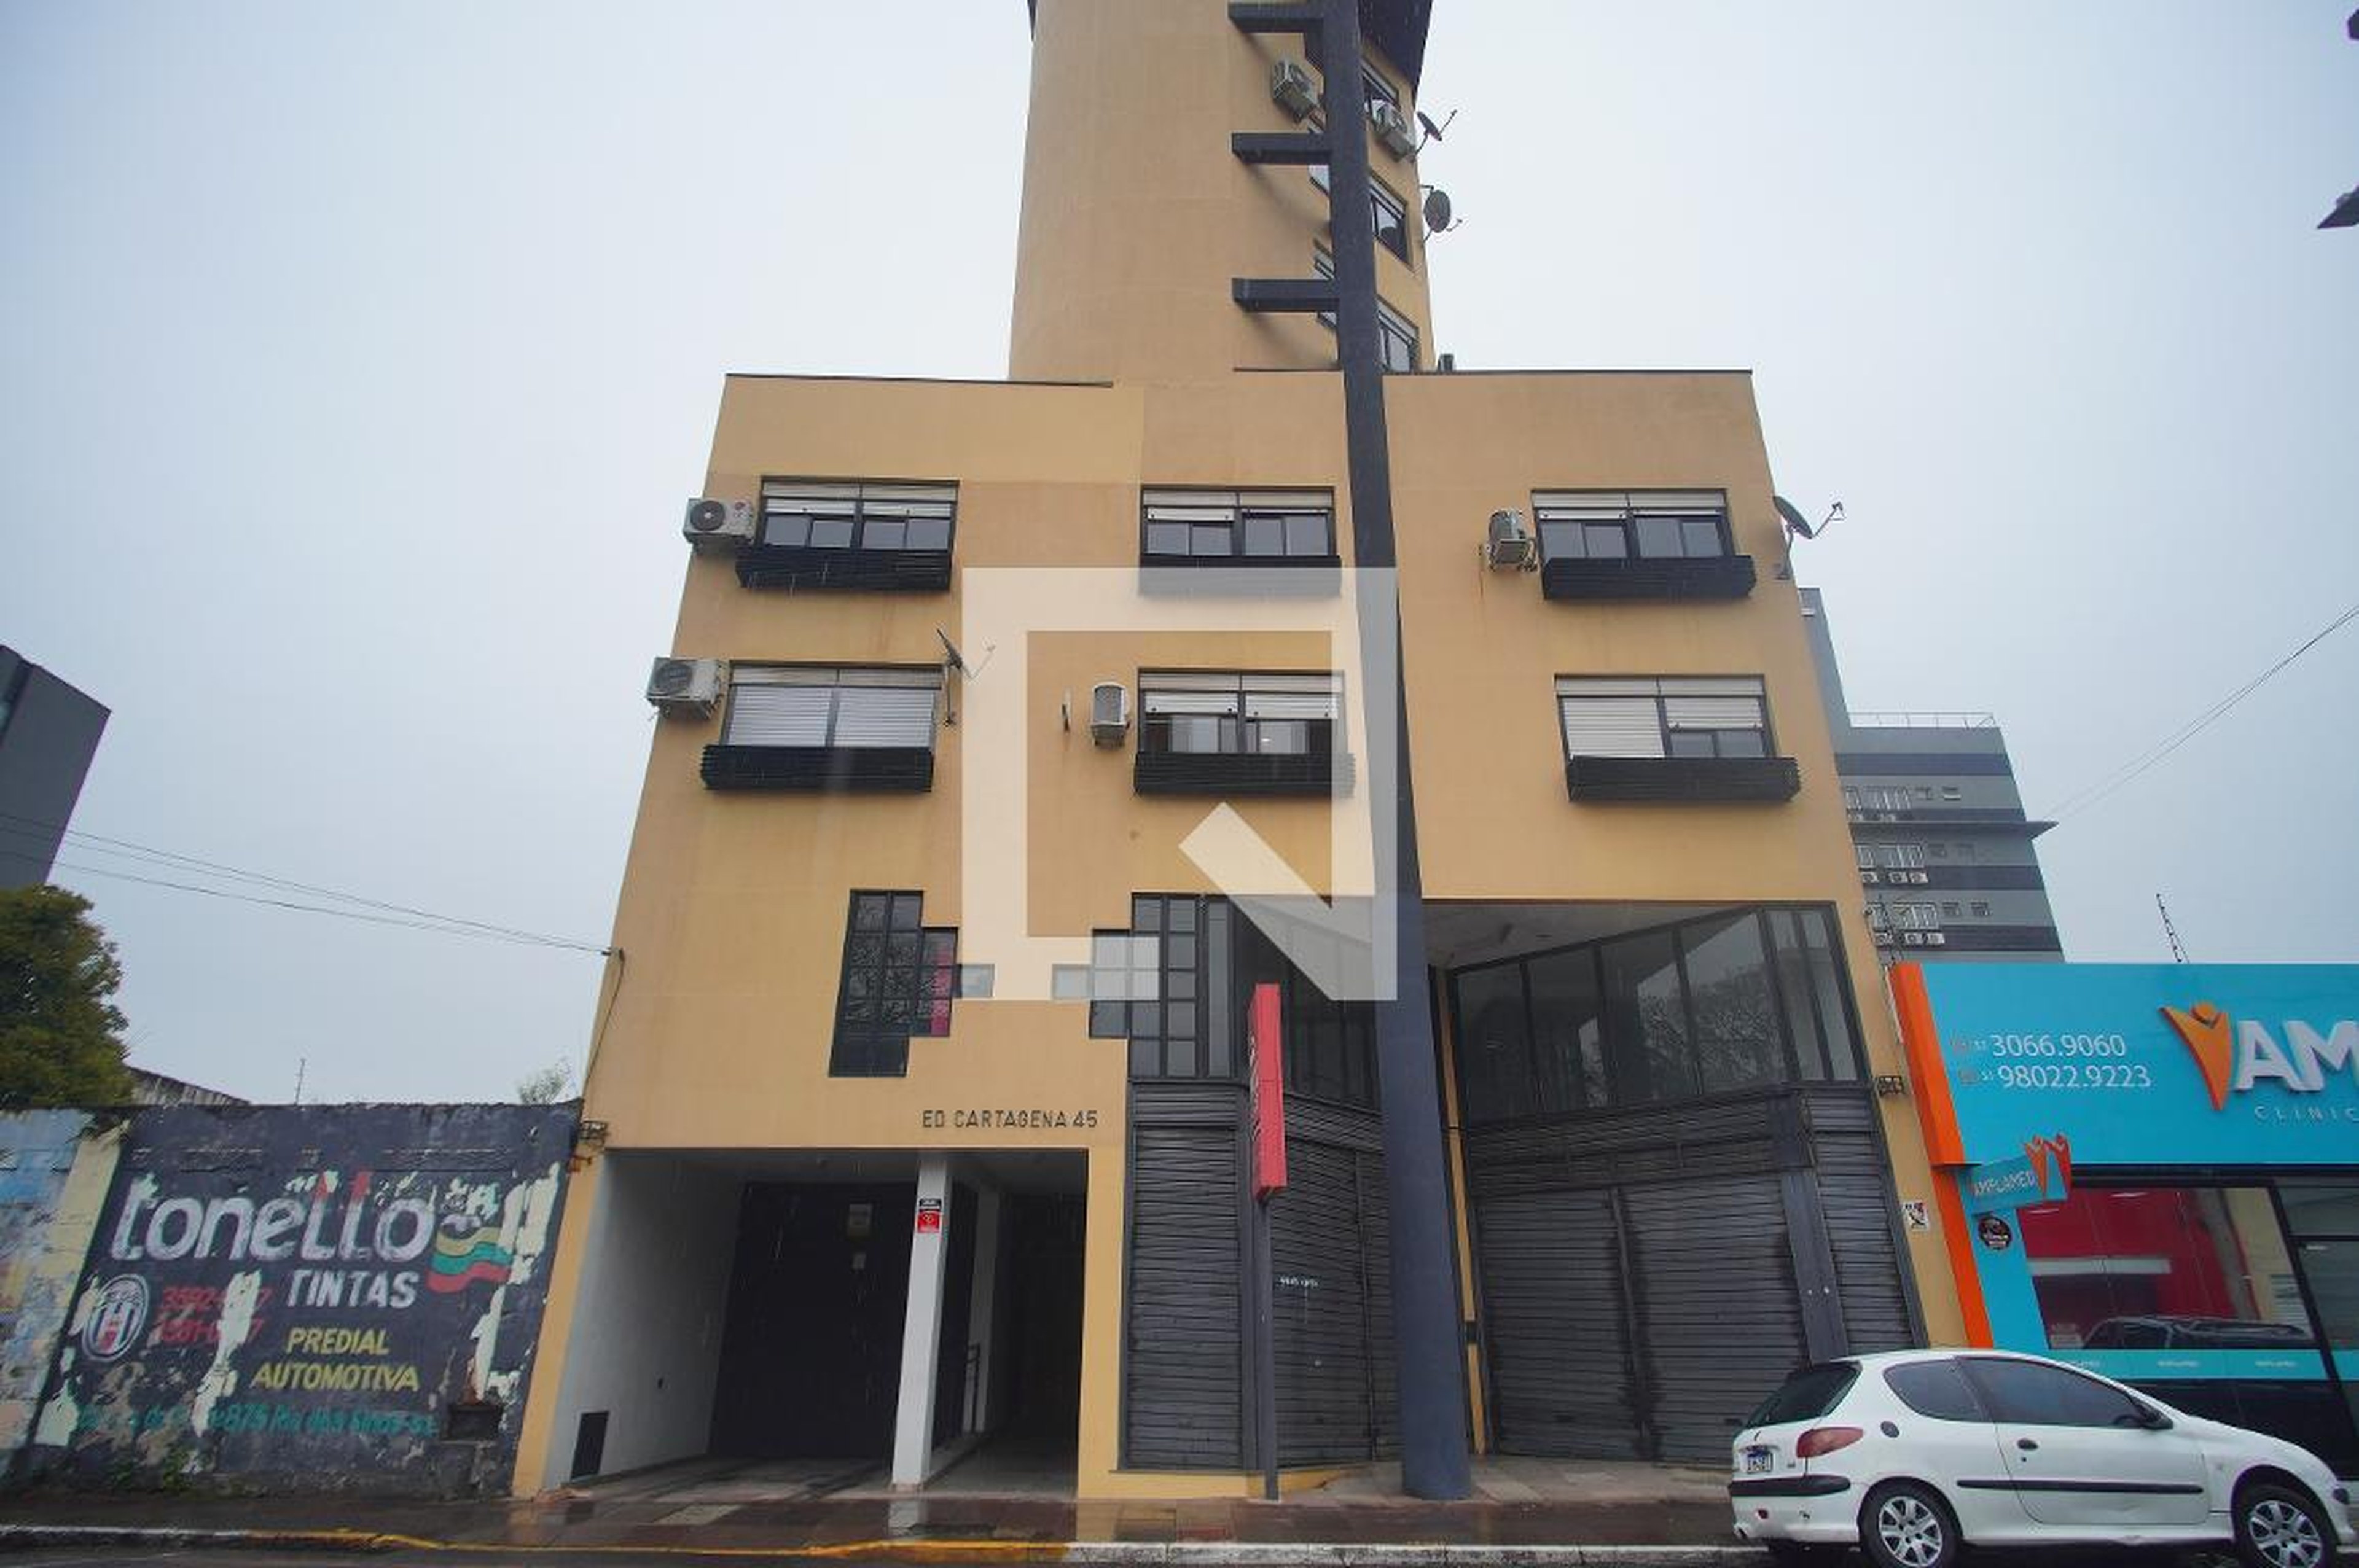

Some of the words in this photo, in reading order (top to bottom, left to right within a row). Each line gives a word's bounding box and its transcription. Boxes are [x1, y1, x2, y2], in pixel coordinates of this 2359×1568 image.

[1990, 1034, 2126, 1057] 3066.9060
[2234, 1020, 2359, 1091] AM
[1998, 1064, 2151, 1088] 98022.9223
[922, 1110, 944, 1128] ED
[954, 1110, 1067, 1128] CARTAGENA
[1073, 1110, 1098, 1128] 45
[288, 1269, 420, 1308] TINTAS
[286, 1327, 391, 1355] PREDIAL
[248, 1361, 420, 1392] AUTOMOTIVA
